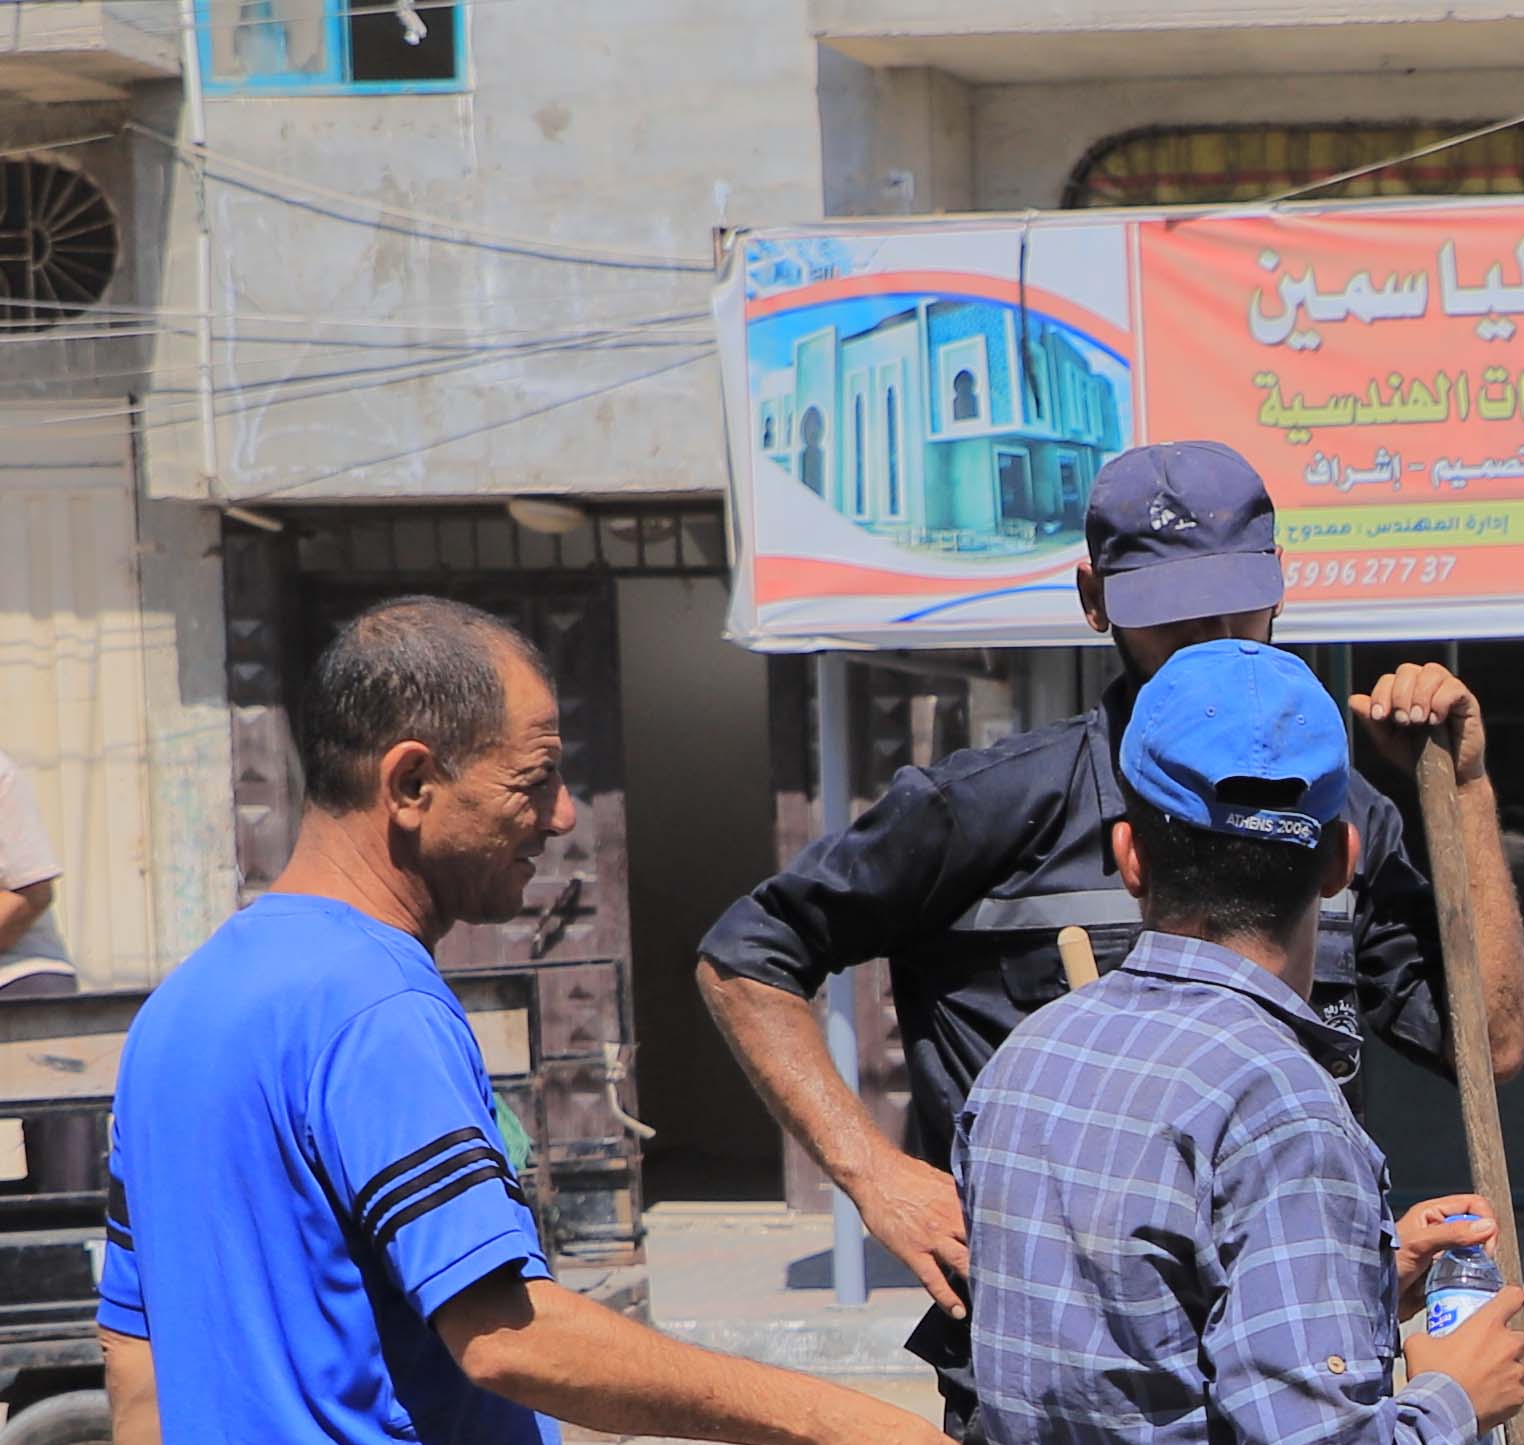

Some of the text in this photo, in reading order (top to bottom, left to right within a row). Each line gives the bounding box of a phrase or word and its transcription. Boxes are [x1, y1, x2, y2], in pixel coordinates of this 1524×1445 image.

[1252, 368, 1471, 443] الهندسية
[1304, 445, 1403, 493] إشراف
[1286, 521, 1352, 545] ممدوح
[1367, 515, 1461, 538] المهندس
[1465, 513, 1510, 536] إدارة
[1225, 812, 1274, 833] ATHENS
